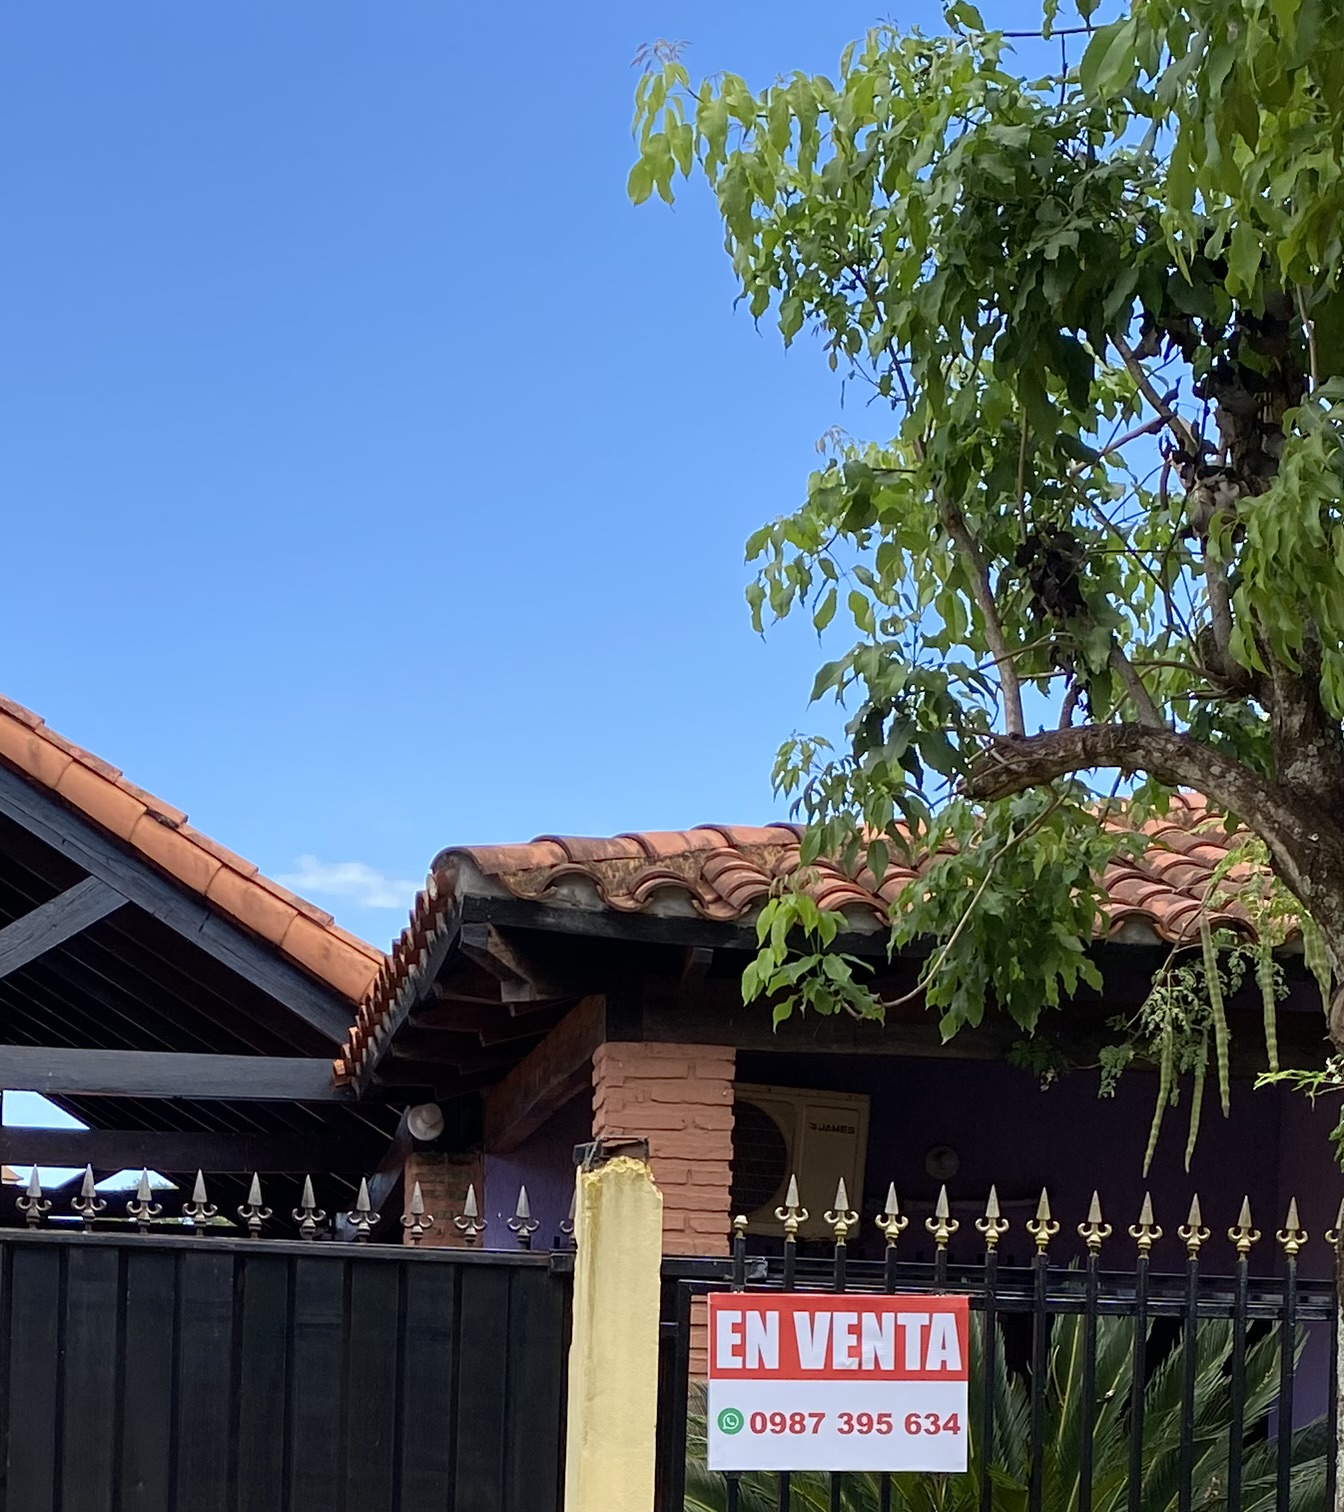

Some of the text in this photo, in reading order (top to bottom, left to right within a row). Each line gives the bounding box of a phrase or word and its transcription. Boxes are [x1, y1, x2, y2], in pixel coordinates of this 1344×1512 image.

[818, 1123, 855, 1134] JAMES
[716, 1310, 963, 1371] EN VENTA
[749, 1411, 961, 1435] 0987 395 634
